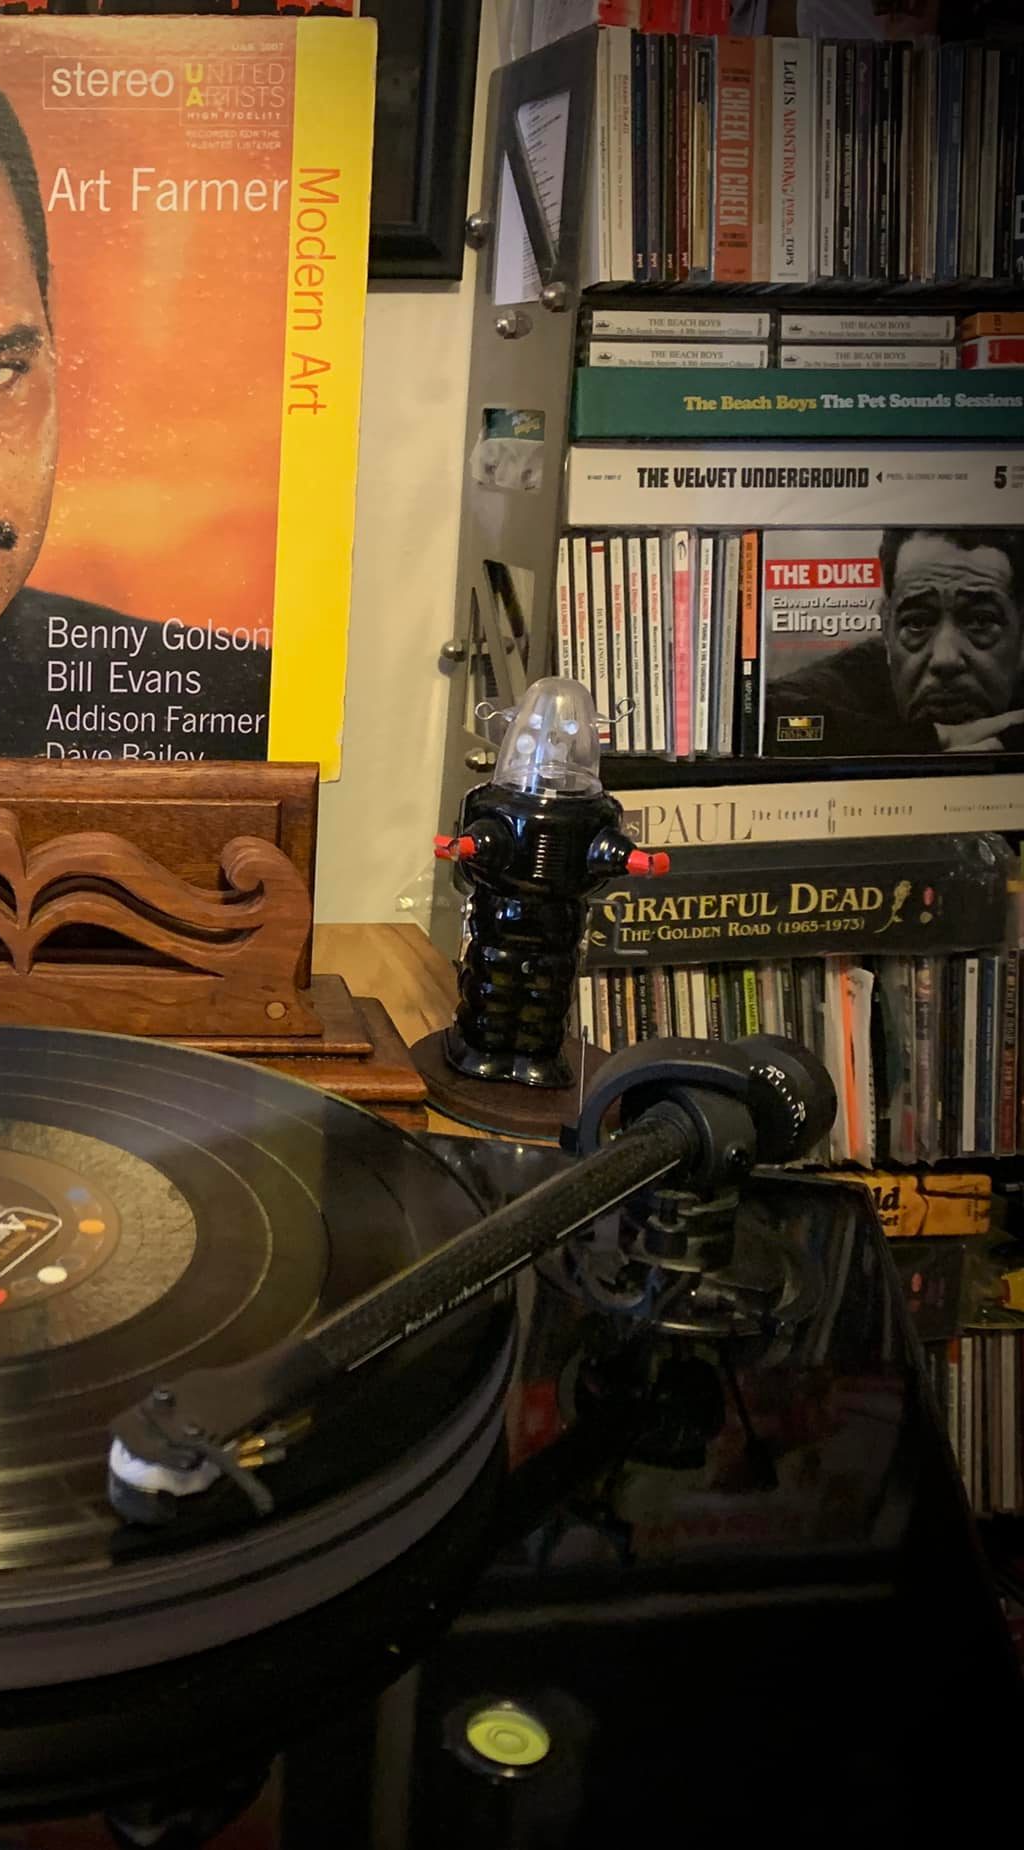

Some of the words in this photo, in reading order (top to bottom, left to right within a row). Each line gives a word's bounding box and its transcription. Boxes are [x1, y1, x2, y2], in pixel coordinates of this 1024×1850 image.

[51, 62, 174, 97] stereo
[184, 63, 286, 84] UNITED
[783, 60, 797, 105] LOUIS
[184, 86, 286, 107] ARTISTS
[187, 111, 218, 120] HIGH
[224, 111, 280, 120] FIDELITY
[720, 88, 750, 142] CHEEK
[263, 130, 280, 138] THE
[719, 146, 749, 169] TO
[781, 109, 796, 193] ARMSTRONG
[47, 167, 112, 212] Art
[132, 167, 288, 212] Farmer
[719, 172, 749, 226] CHEEK
[293, 166, 340, 332] Modern
[785, 236, 796, 266] TOPS
[649, 319, 665, 327] THE
[667, 319, 697, 327] BEACH
[699, 319, 721, 327] BOYS
[840, 321, 855, 329] THE
[857, 321, 886, 329] BEACH
[888, 321, 910, 329] BOYS
[650, 351, 665, 359] THE
[669, 351, 699, 359] BEACH
[701, 351, 724, 359] BOYS
[835, 352, 850, 360] THE
[853, 352, 881, 360] BEACH
[883, 352, 906, 360] BOYS
[287, 351, 332, 416] Art
[683, 396, 717, 410] The
[721, 395, 772, 410] Beach
[775, 395, 817, 412] Boys
[820, 394, 853, 408] The
[857, 394, 887, 408] Pet
[889, 394, 951, 408] Sounds
[955, 393, 1023, 407] Sessions
[637, 467, 669, 488] THE
[673, 467, 737, 488] VELVET
[741, 467, 870, 488] UNDERGROUND
[994, 465, 1007, 489] 5
[770, 564, 810, 585] THE
[817, 563, 874, 584] DUKE
[772, 595, 821, 608] Edward
[822, 596, 875, 609] Kennedy
[771, 610, 882, 636] Ellington
[48, 616, 148, 657] Benny
[162, 617, 272, 651] Golson
[47, 660, 93, 693] Bill
[109, 661, 202, 694] Evans
[46, 703, 156, 733] Addison
[167, 705, 266, 734] Farmer
[46, 742, 112, 761] Dave
[642, 801, 753, 844] PAUL
[751, 809, 771, 821] The
[842, 804, 863, 816] The
[603, 891, 778, 923] GRATEFUL
[788, 883, 883, 914] DEAD
[620, 927, 653, 942] THE
[657, 925, 721, 940] GOLDEN
[728, 921, 771, 936] ROAD
[776, 918, 865, 935] (1965-1973)
